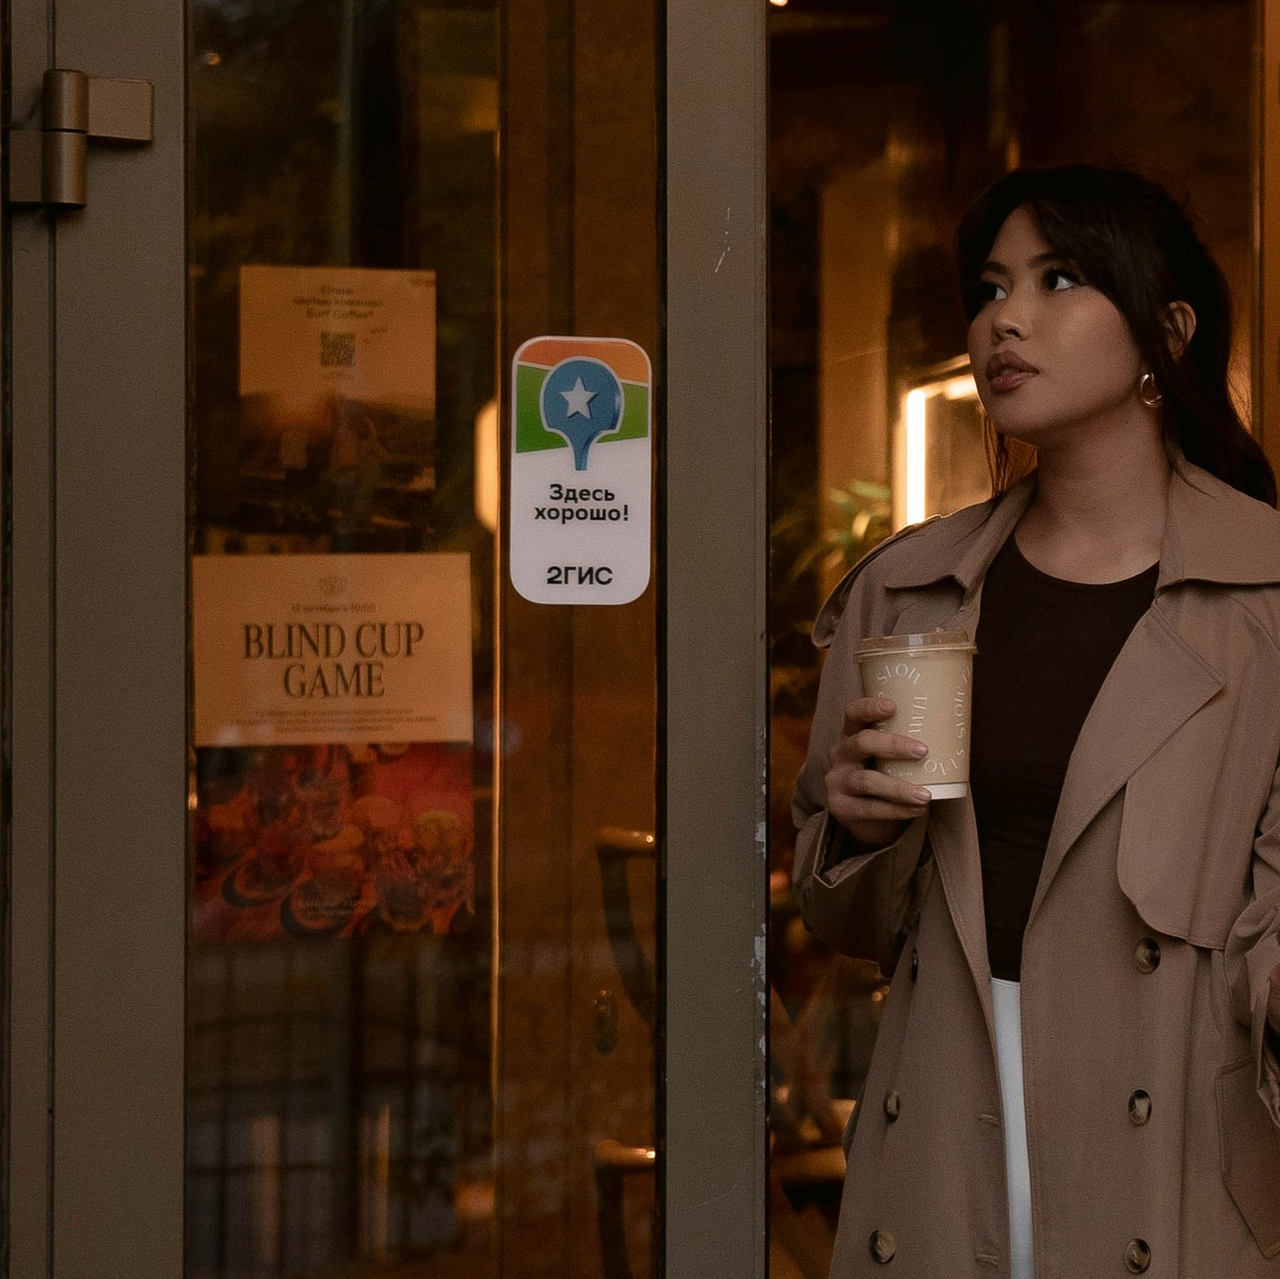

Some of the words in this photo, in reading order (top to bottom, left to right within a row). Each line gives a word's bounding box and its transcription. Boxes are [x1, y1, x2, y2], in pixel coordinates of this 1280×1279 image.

[549, 483, 615, 503] Здесь
[534, 505, 628, 525] хорошо!
[547, 566, 613, 585] 2ГИС
[244, 623, 346, 660] BLIND
[356, 622, 424, 659] CUP
[284, 661, 386, 699] GAME
